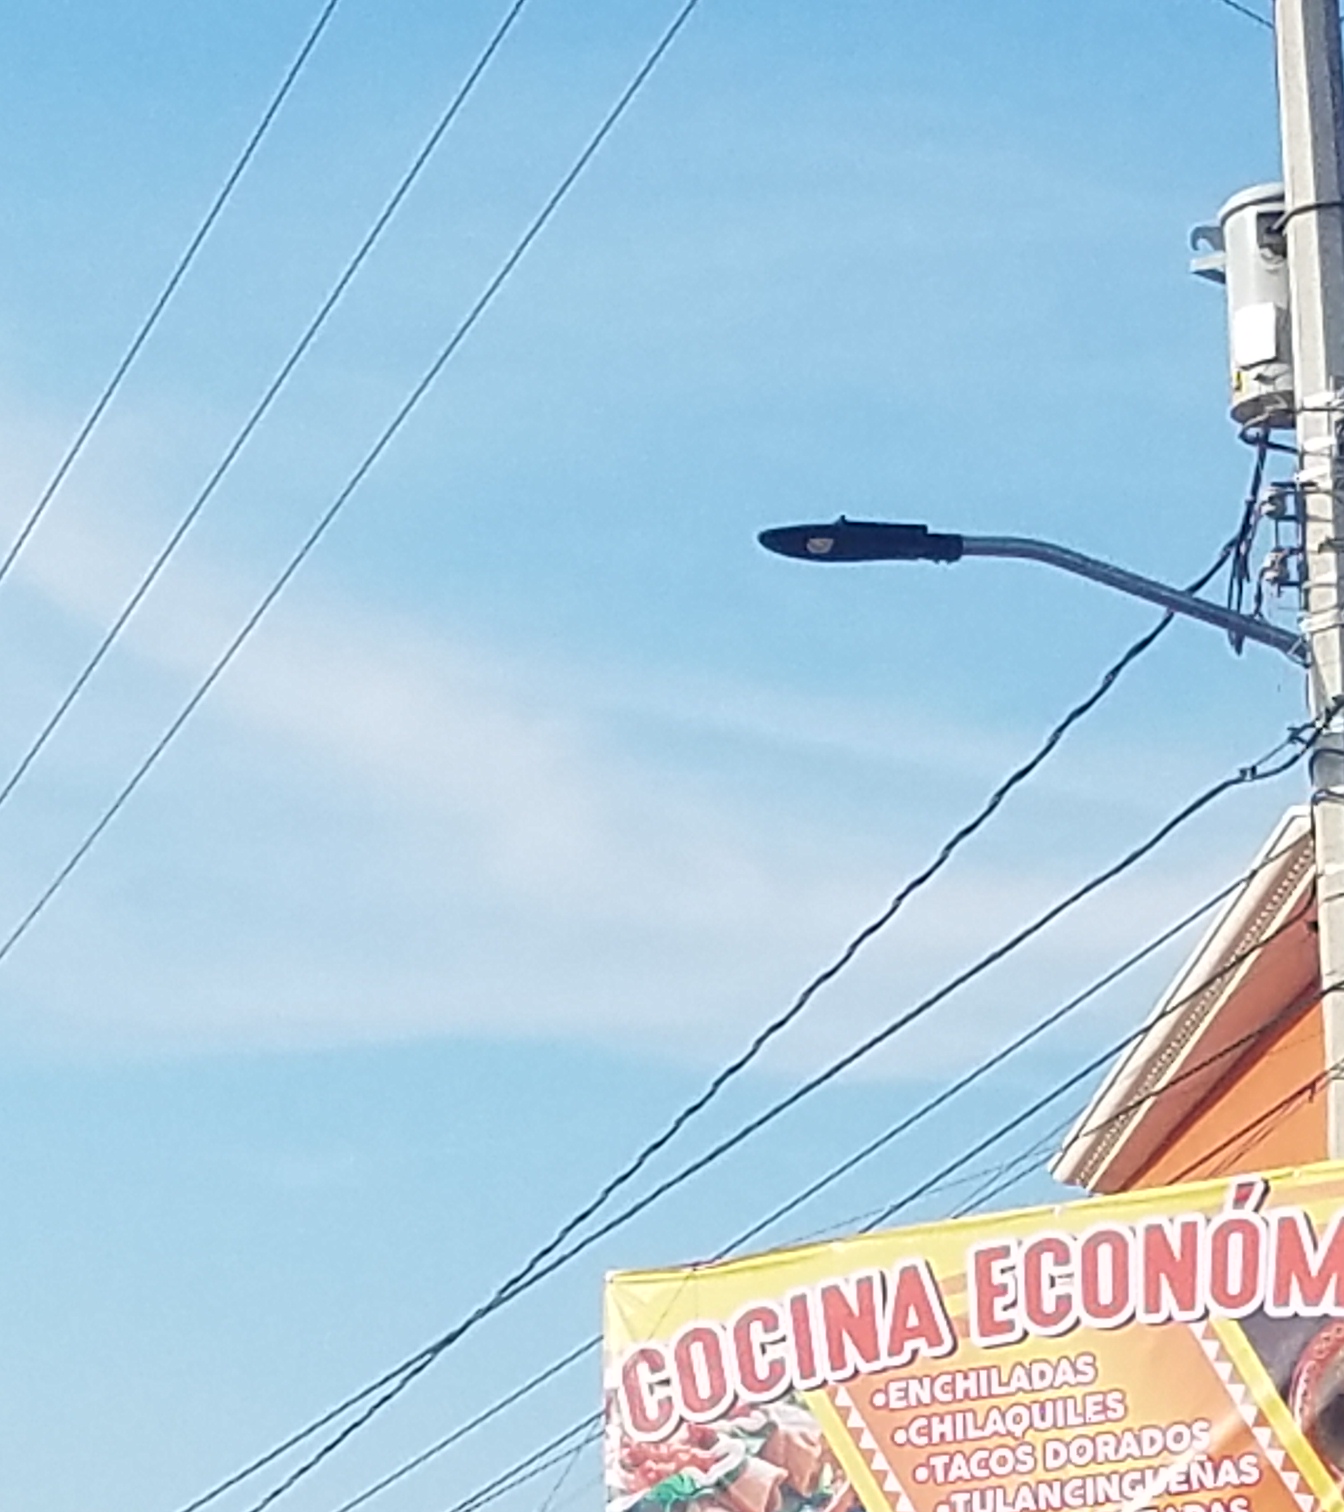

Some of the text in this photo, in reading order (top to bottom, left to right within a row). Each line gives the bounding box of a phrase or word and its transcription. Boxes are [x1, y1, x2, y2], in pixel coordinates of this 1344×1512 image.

[621, 1260, 953, 1441] COCINA
[887, 1354, 1097, 1409] ENCHILADAS
[908, 1391, 1126, 1445] CHILAQUILES
[930, 1420, 1211, 1482] TACOS DORADOS
